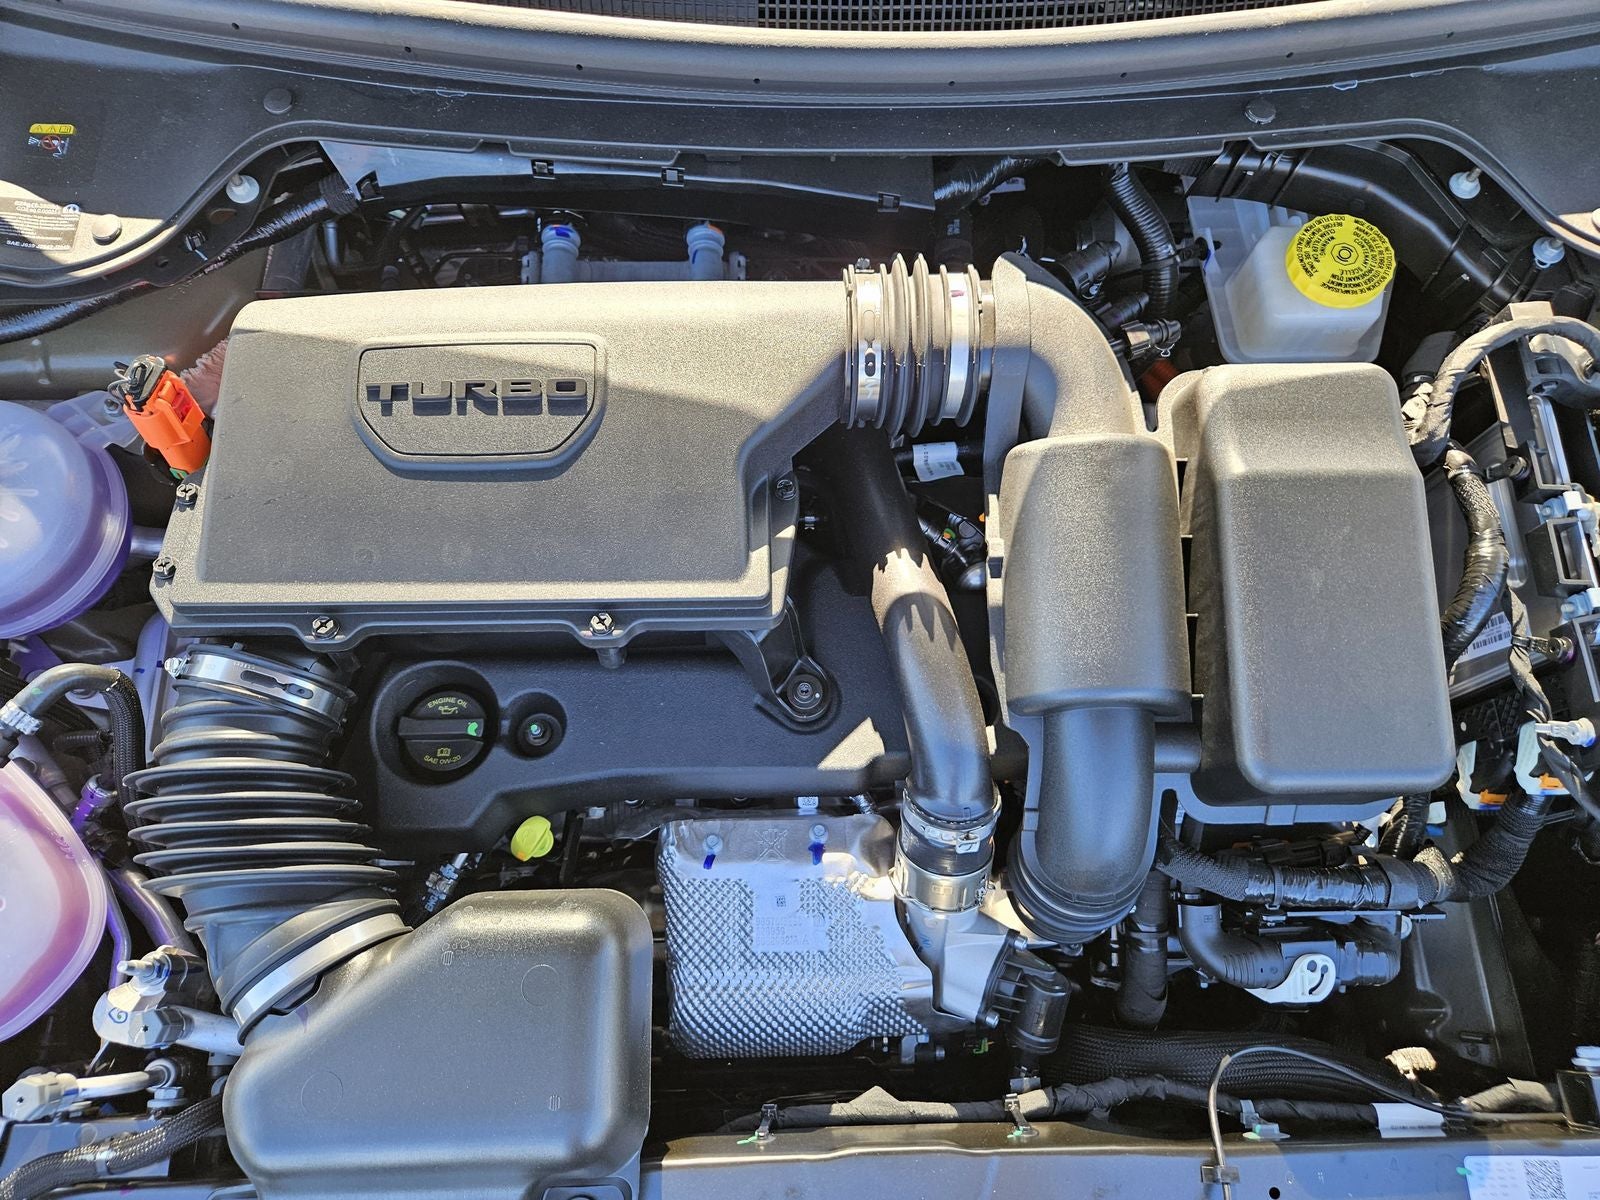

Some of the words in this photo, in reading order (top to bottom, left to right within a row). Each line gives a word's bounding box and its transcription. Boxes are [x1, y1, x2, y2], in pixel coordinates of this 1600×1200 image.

[1322, 221, 1343, 230] BEFORE
[366, 378, 588, 411] TURBO
[427, 696, 457, 709] ENGINE
[457, 698, 469, 709] OIL
[423, 754, 439, 765] SAE
[439, 754, 462, 765] 0W-20
